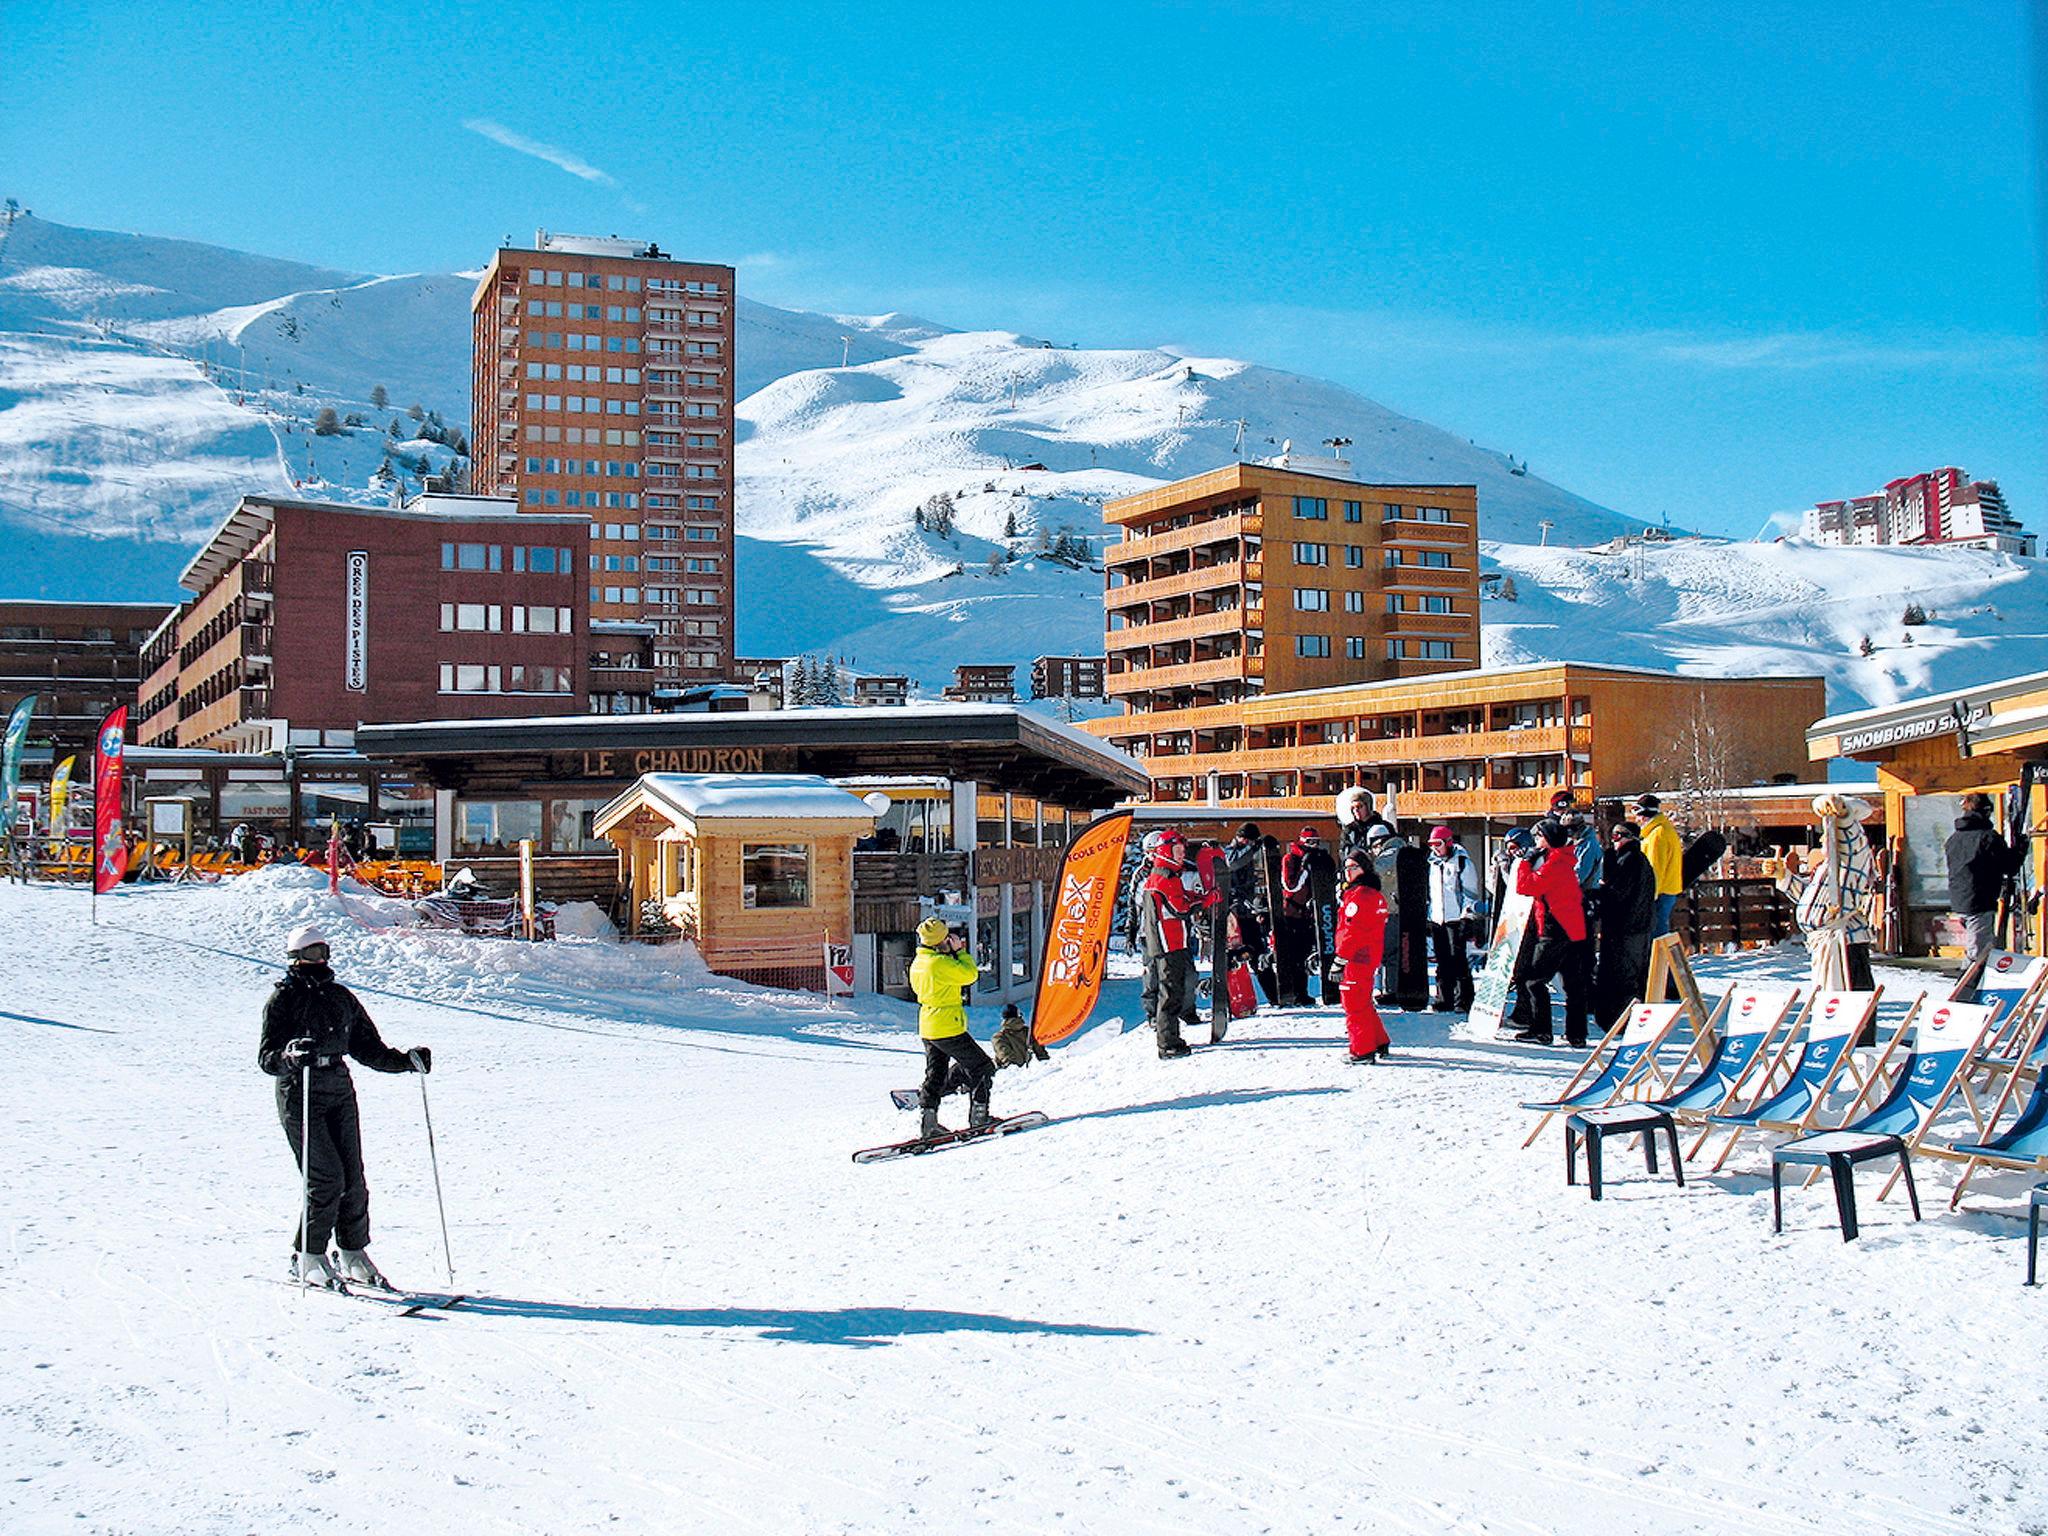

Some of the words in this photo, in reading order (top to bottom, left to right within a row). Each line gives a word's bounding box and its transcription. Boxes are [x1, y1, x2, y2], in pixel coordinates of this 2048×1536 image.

[352, 558, 362, 596] OREE
[352, 599, 362, 628] DES
[352, 629, 362, 687] PISTES
[1841, 718, 1937, 751] SNOWBOARD
[583, 751, 615, 777] LE
[634, 748, 764, 774] CHAUDRON
[243, 806, 263, 815] FAST
[267, 806, 289, 816] FOOD
[1097, 841, 1109, 852] DE
[1111, 833, 1125, 844] SKI
[1088, 877, 1105, 929] School
[1084, 930, 1096, 954] Ski
[1321, 903, 1335, 955] burton
